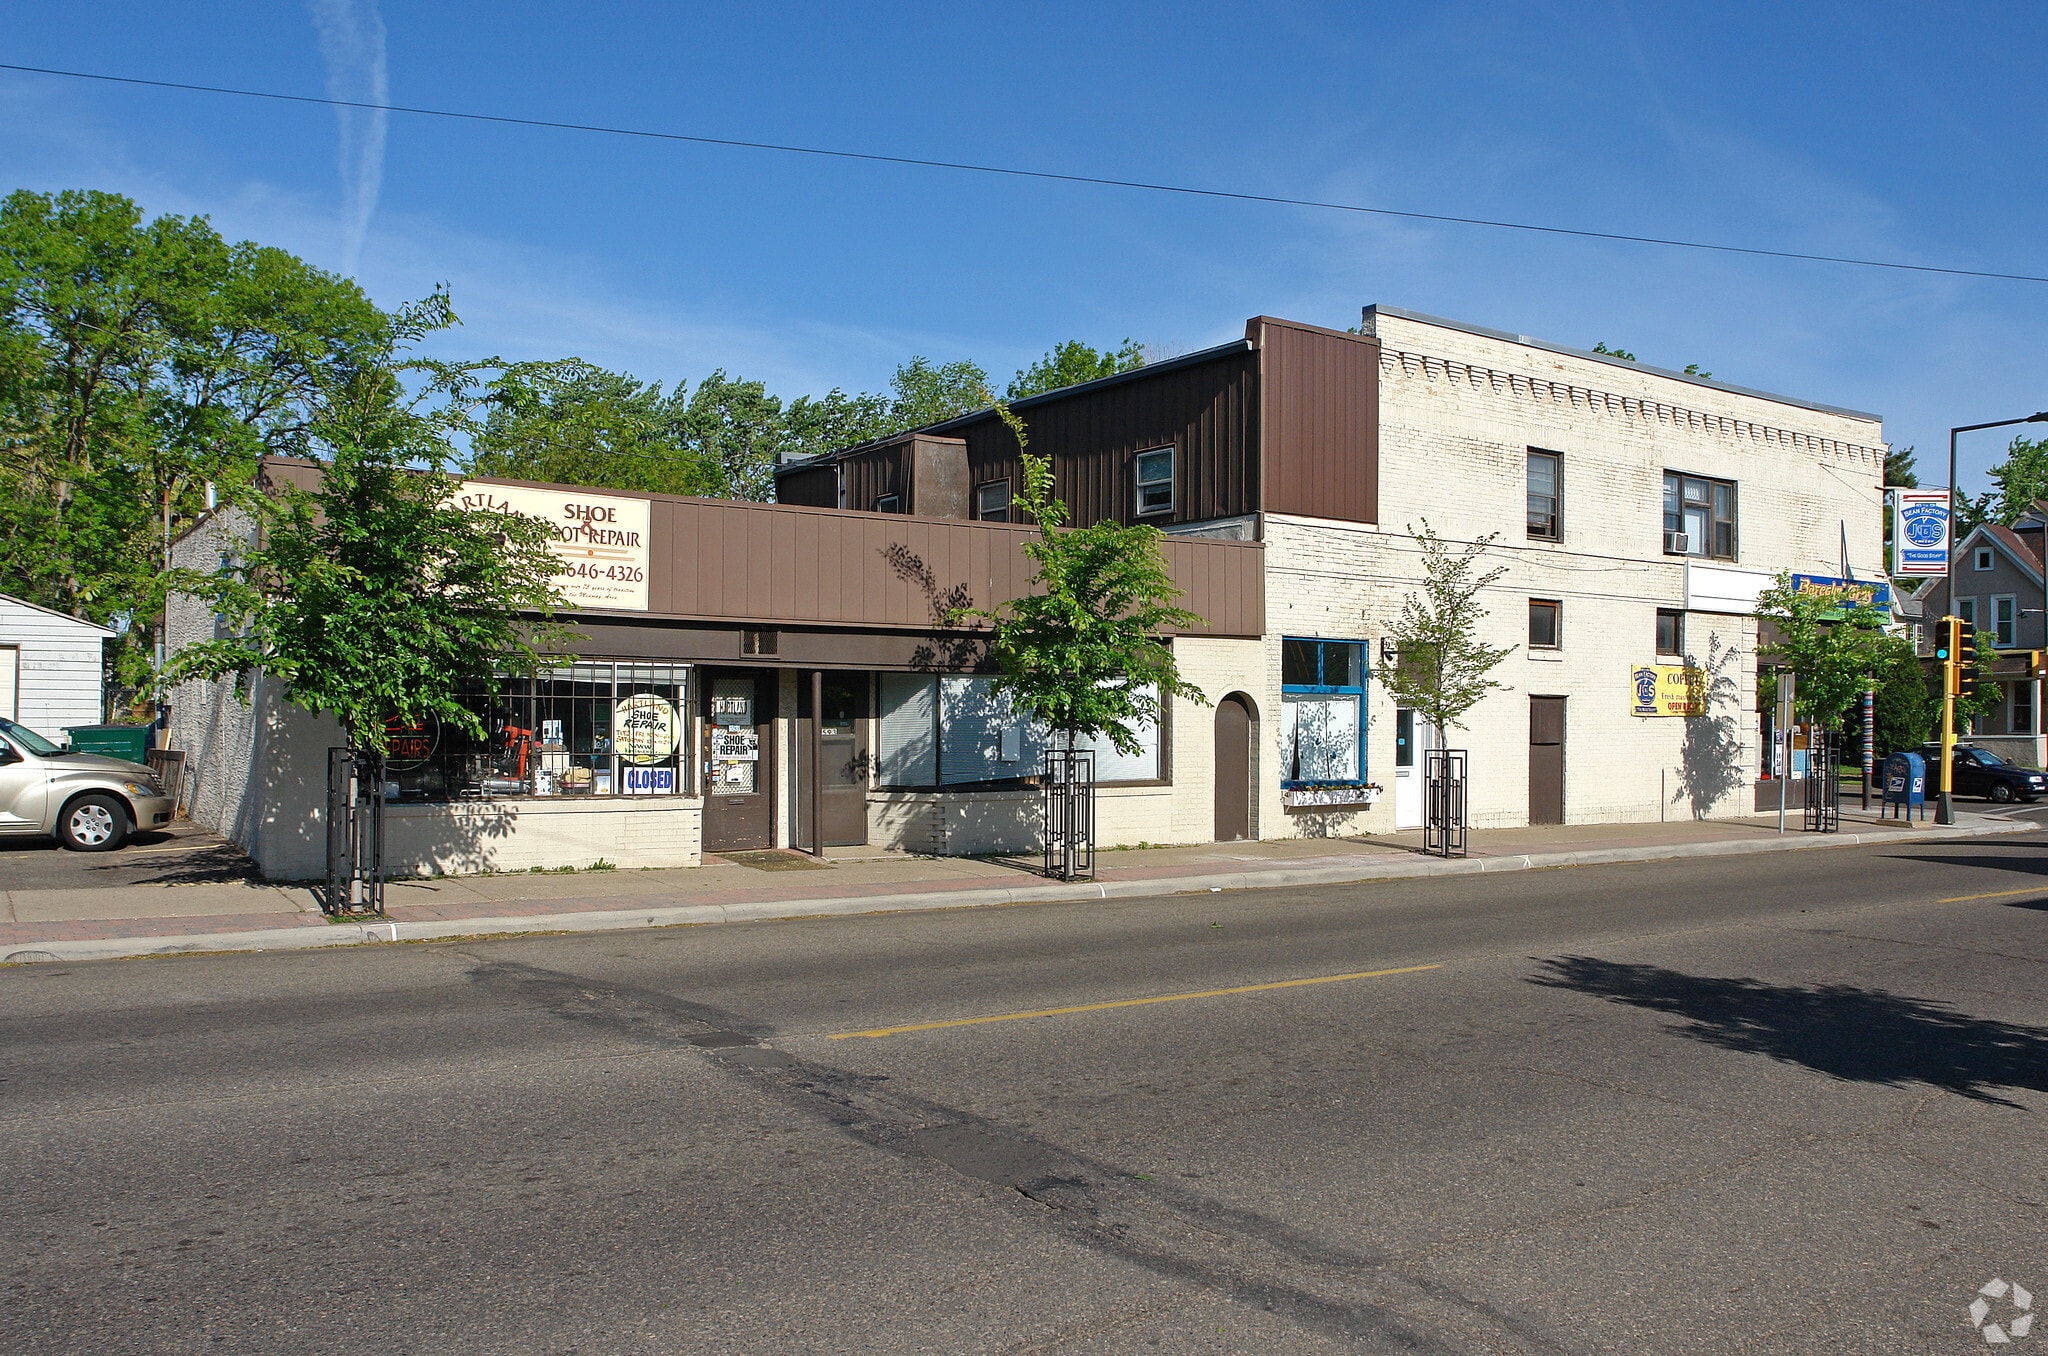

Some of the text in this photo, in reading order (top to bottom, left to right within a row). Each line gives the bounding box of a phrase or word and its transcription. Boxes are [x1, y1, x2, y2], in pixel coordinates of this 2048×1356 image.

[563, 503, 617, 523] SHOE
[1903, 506, 1948, 518] BEAN FACTORY
[550, 525, 641, 548] OOT REPAIR
[1667, 702, 1682, 711] OPEN
[631, 710, 659, 722] SHOE
[623, 719, 667, 732] REPAIR
[723, 735, 745, 745] SHOE
[384, 738, 430, 758] EPAIRS
[720, 745, 748, 755] REPAIR
[627, 770, 672, 788] CLOSED
